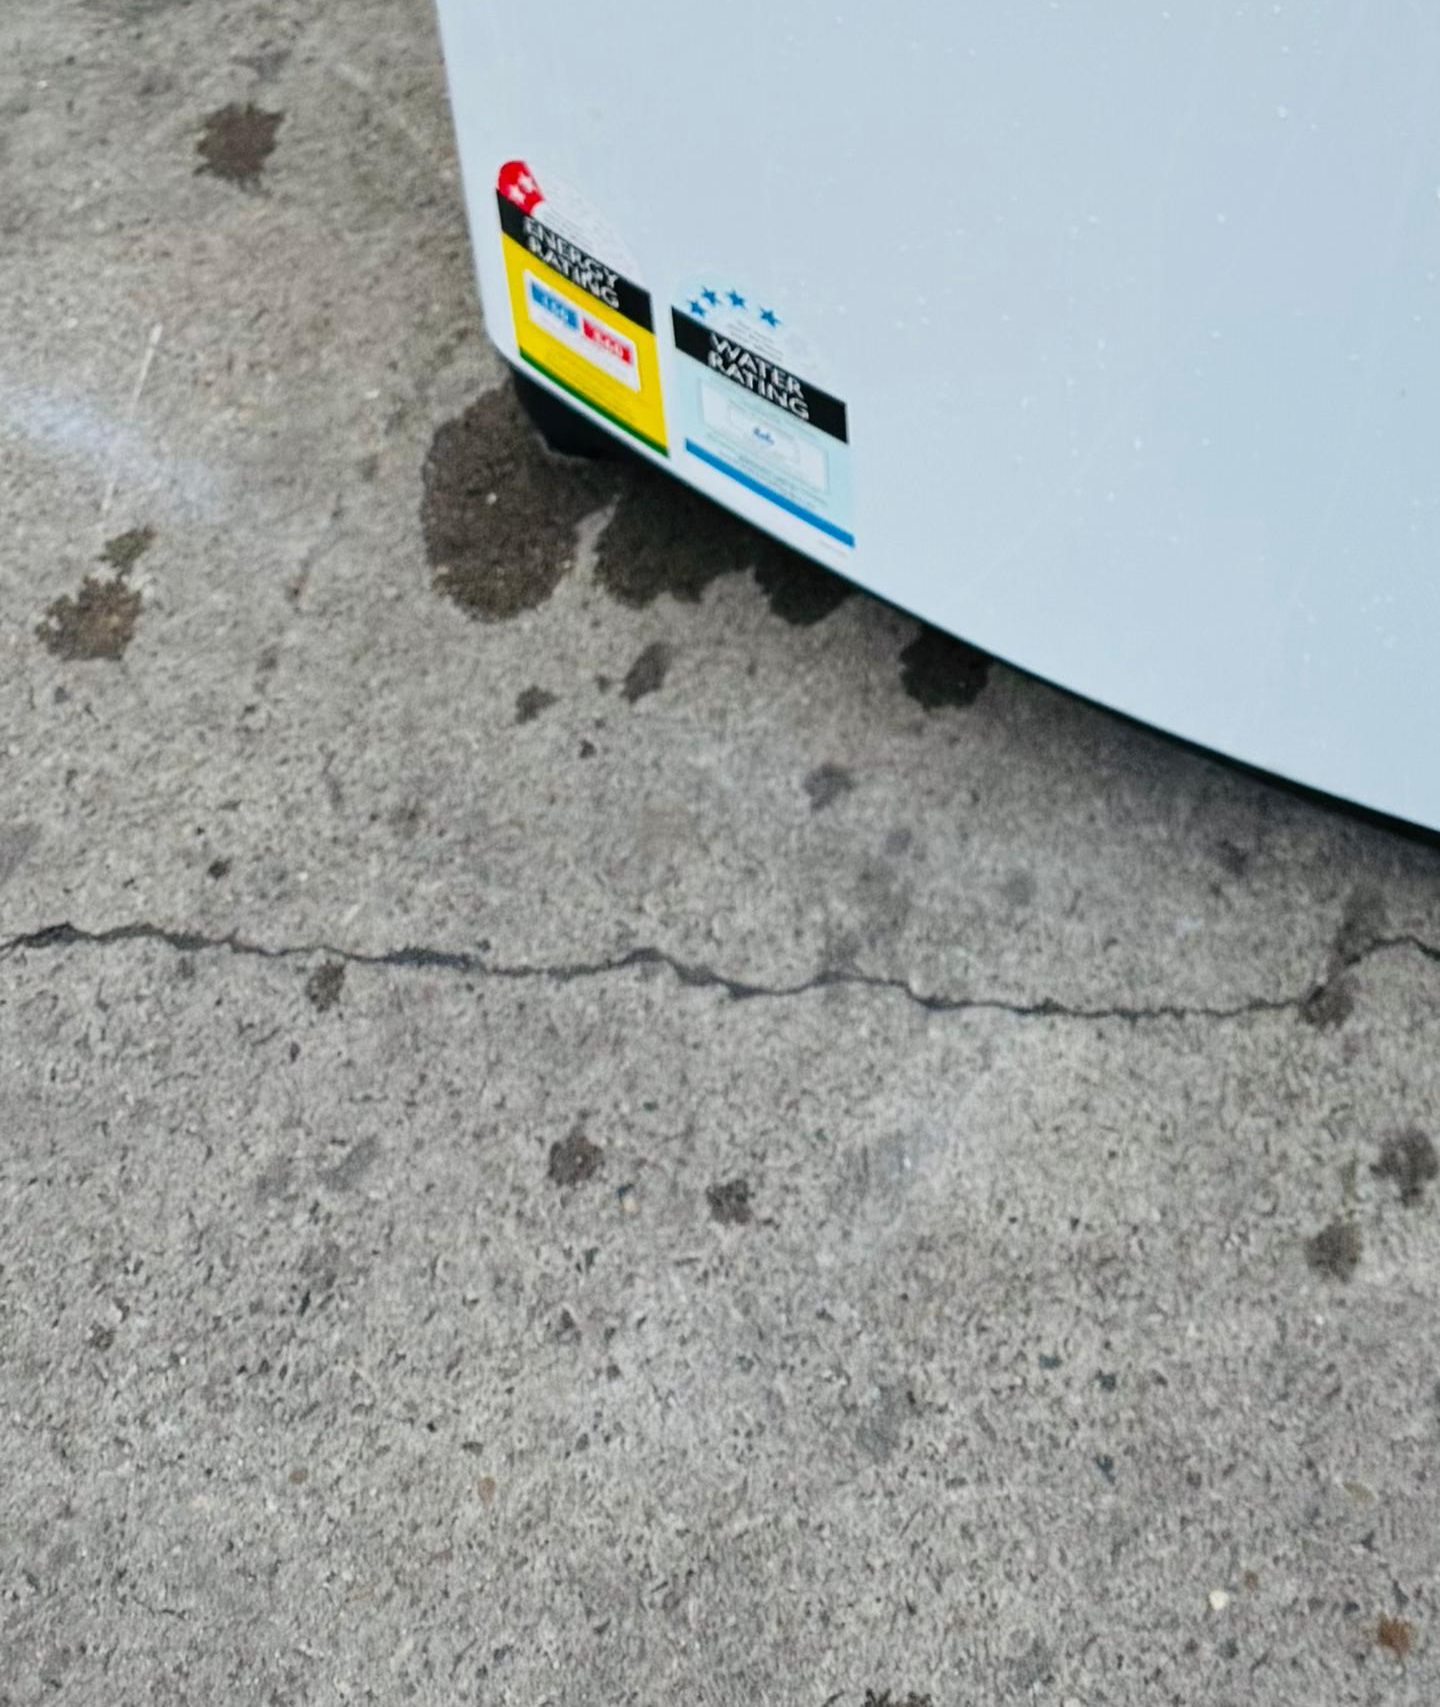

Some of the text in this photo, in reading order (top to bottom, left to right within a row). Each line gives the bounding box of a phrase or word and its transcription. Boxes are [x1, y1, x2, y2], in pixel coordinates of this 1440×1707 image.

[523, 215, 618, 289] ENERGY
[528, 235, 620, 309] RATING
[708, 350, 810, 420] RATING
[710, 331, 805, 400] WATER
